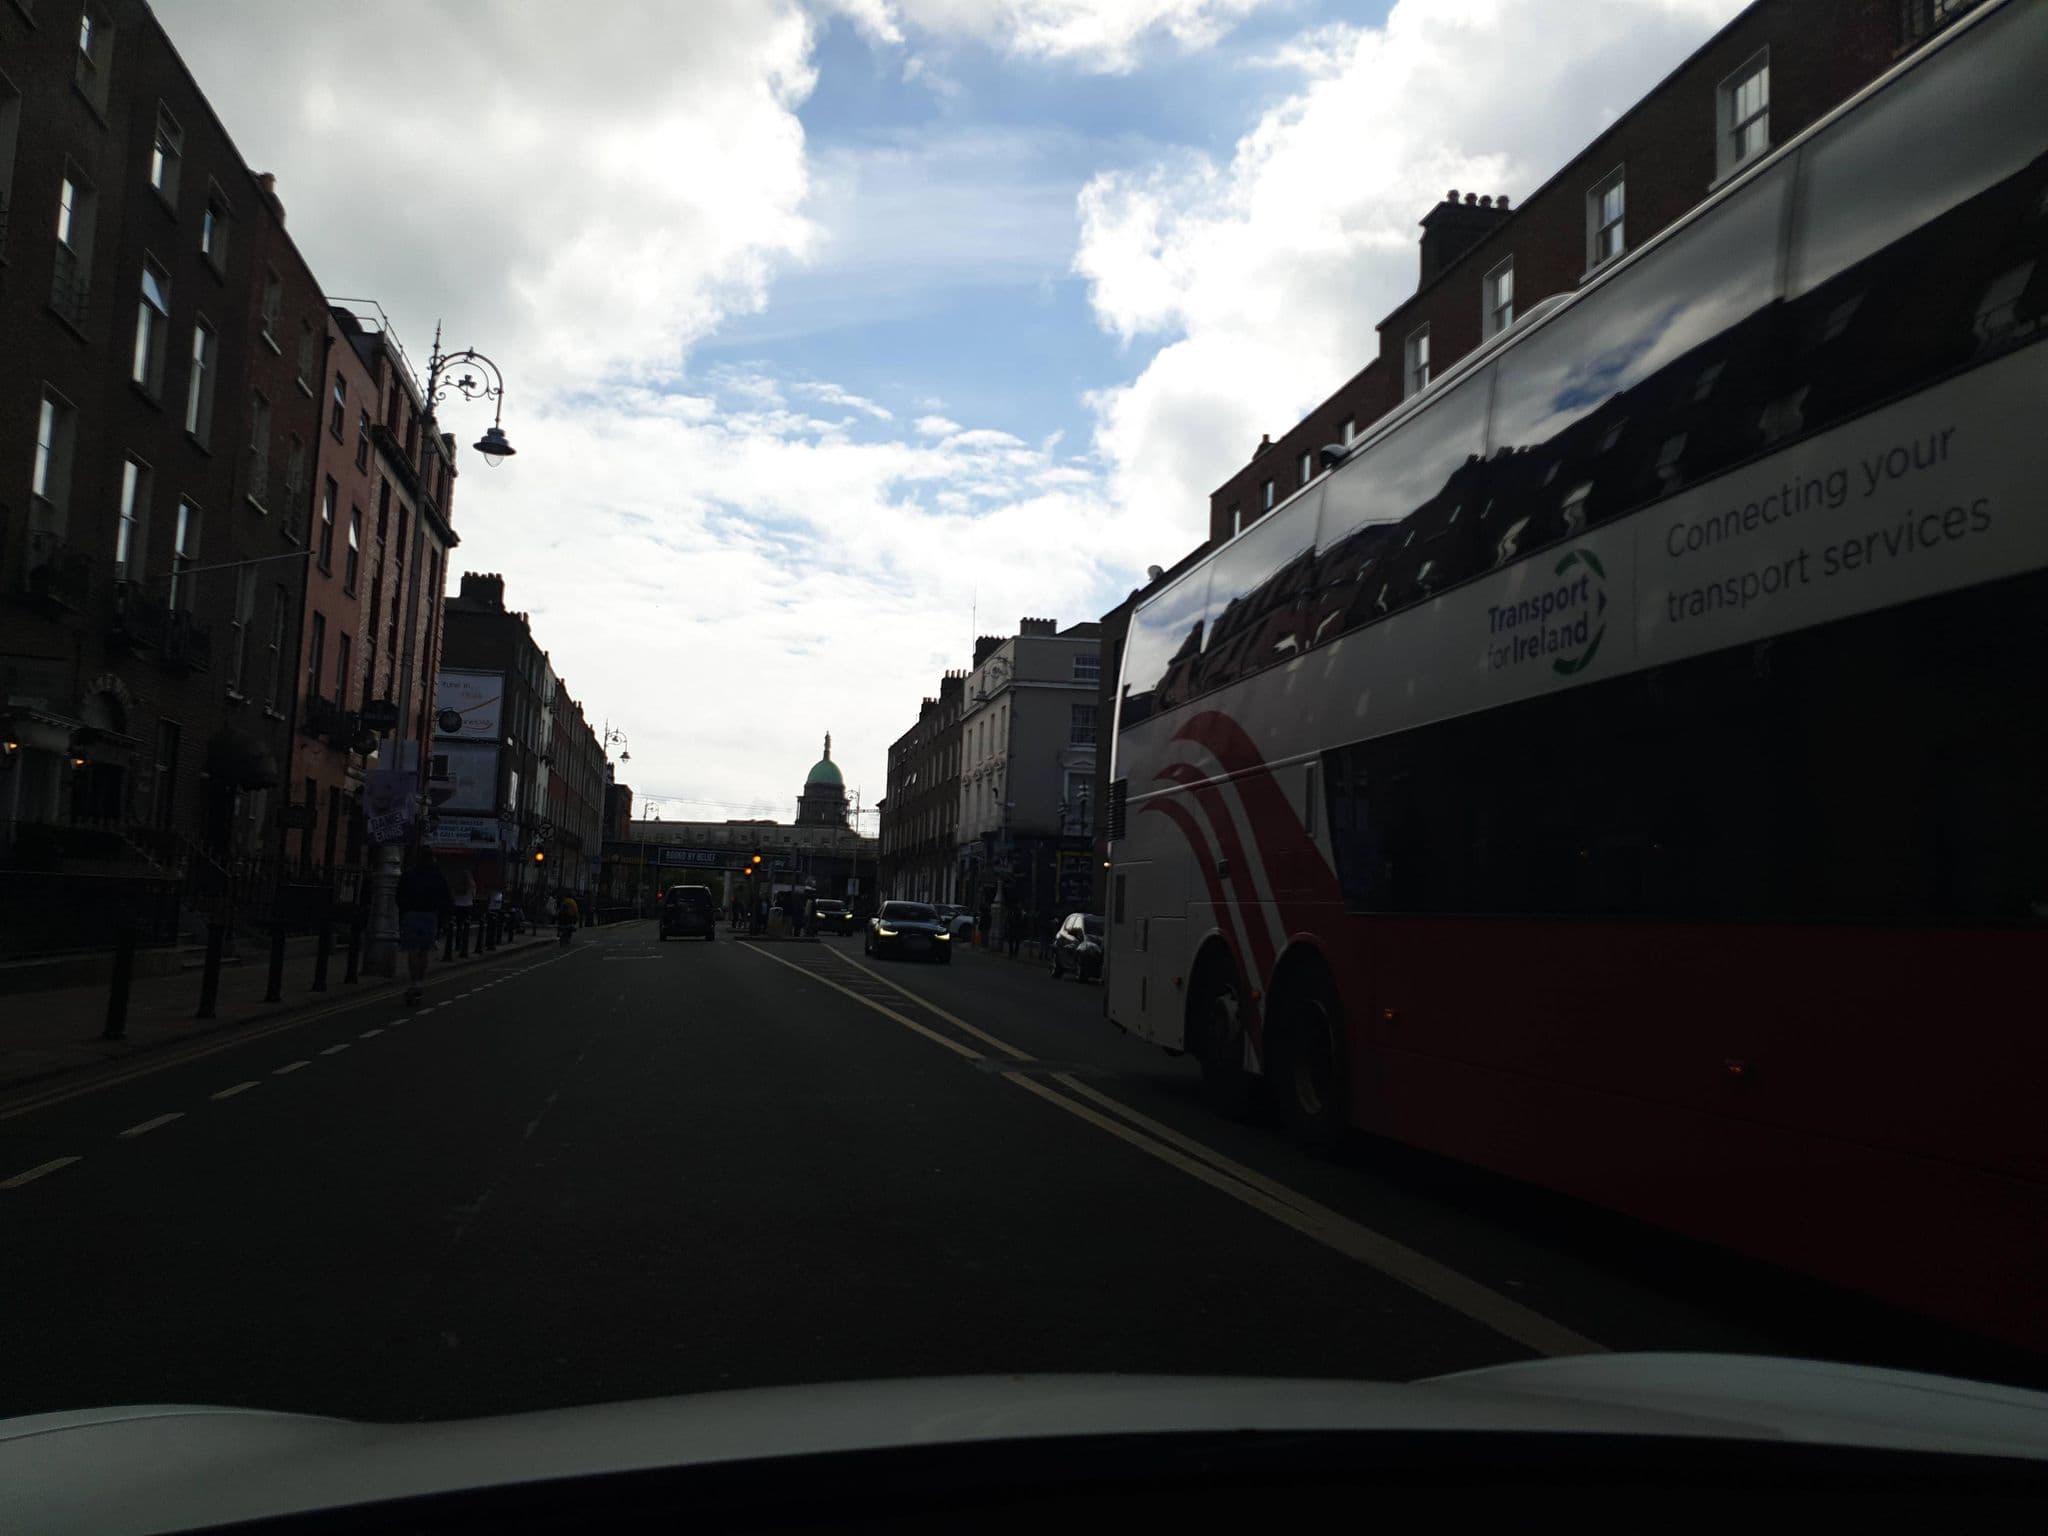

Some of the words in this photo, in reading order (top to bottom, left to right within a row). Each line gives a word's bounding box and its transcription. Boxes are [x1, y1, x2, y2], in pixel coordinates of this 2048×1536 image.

[1667, 468, 1847, 557] Connecting
[1861, 427, 1956, 497] your
[1488, 574, 1588, 634] Transport
[1667, 548, 1810, 622] transport
[1823, 498, 1992, 576] services
